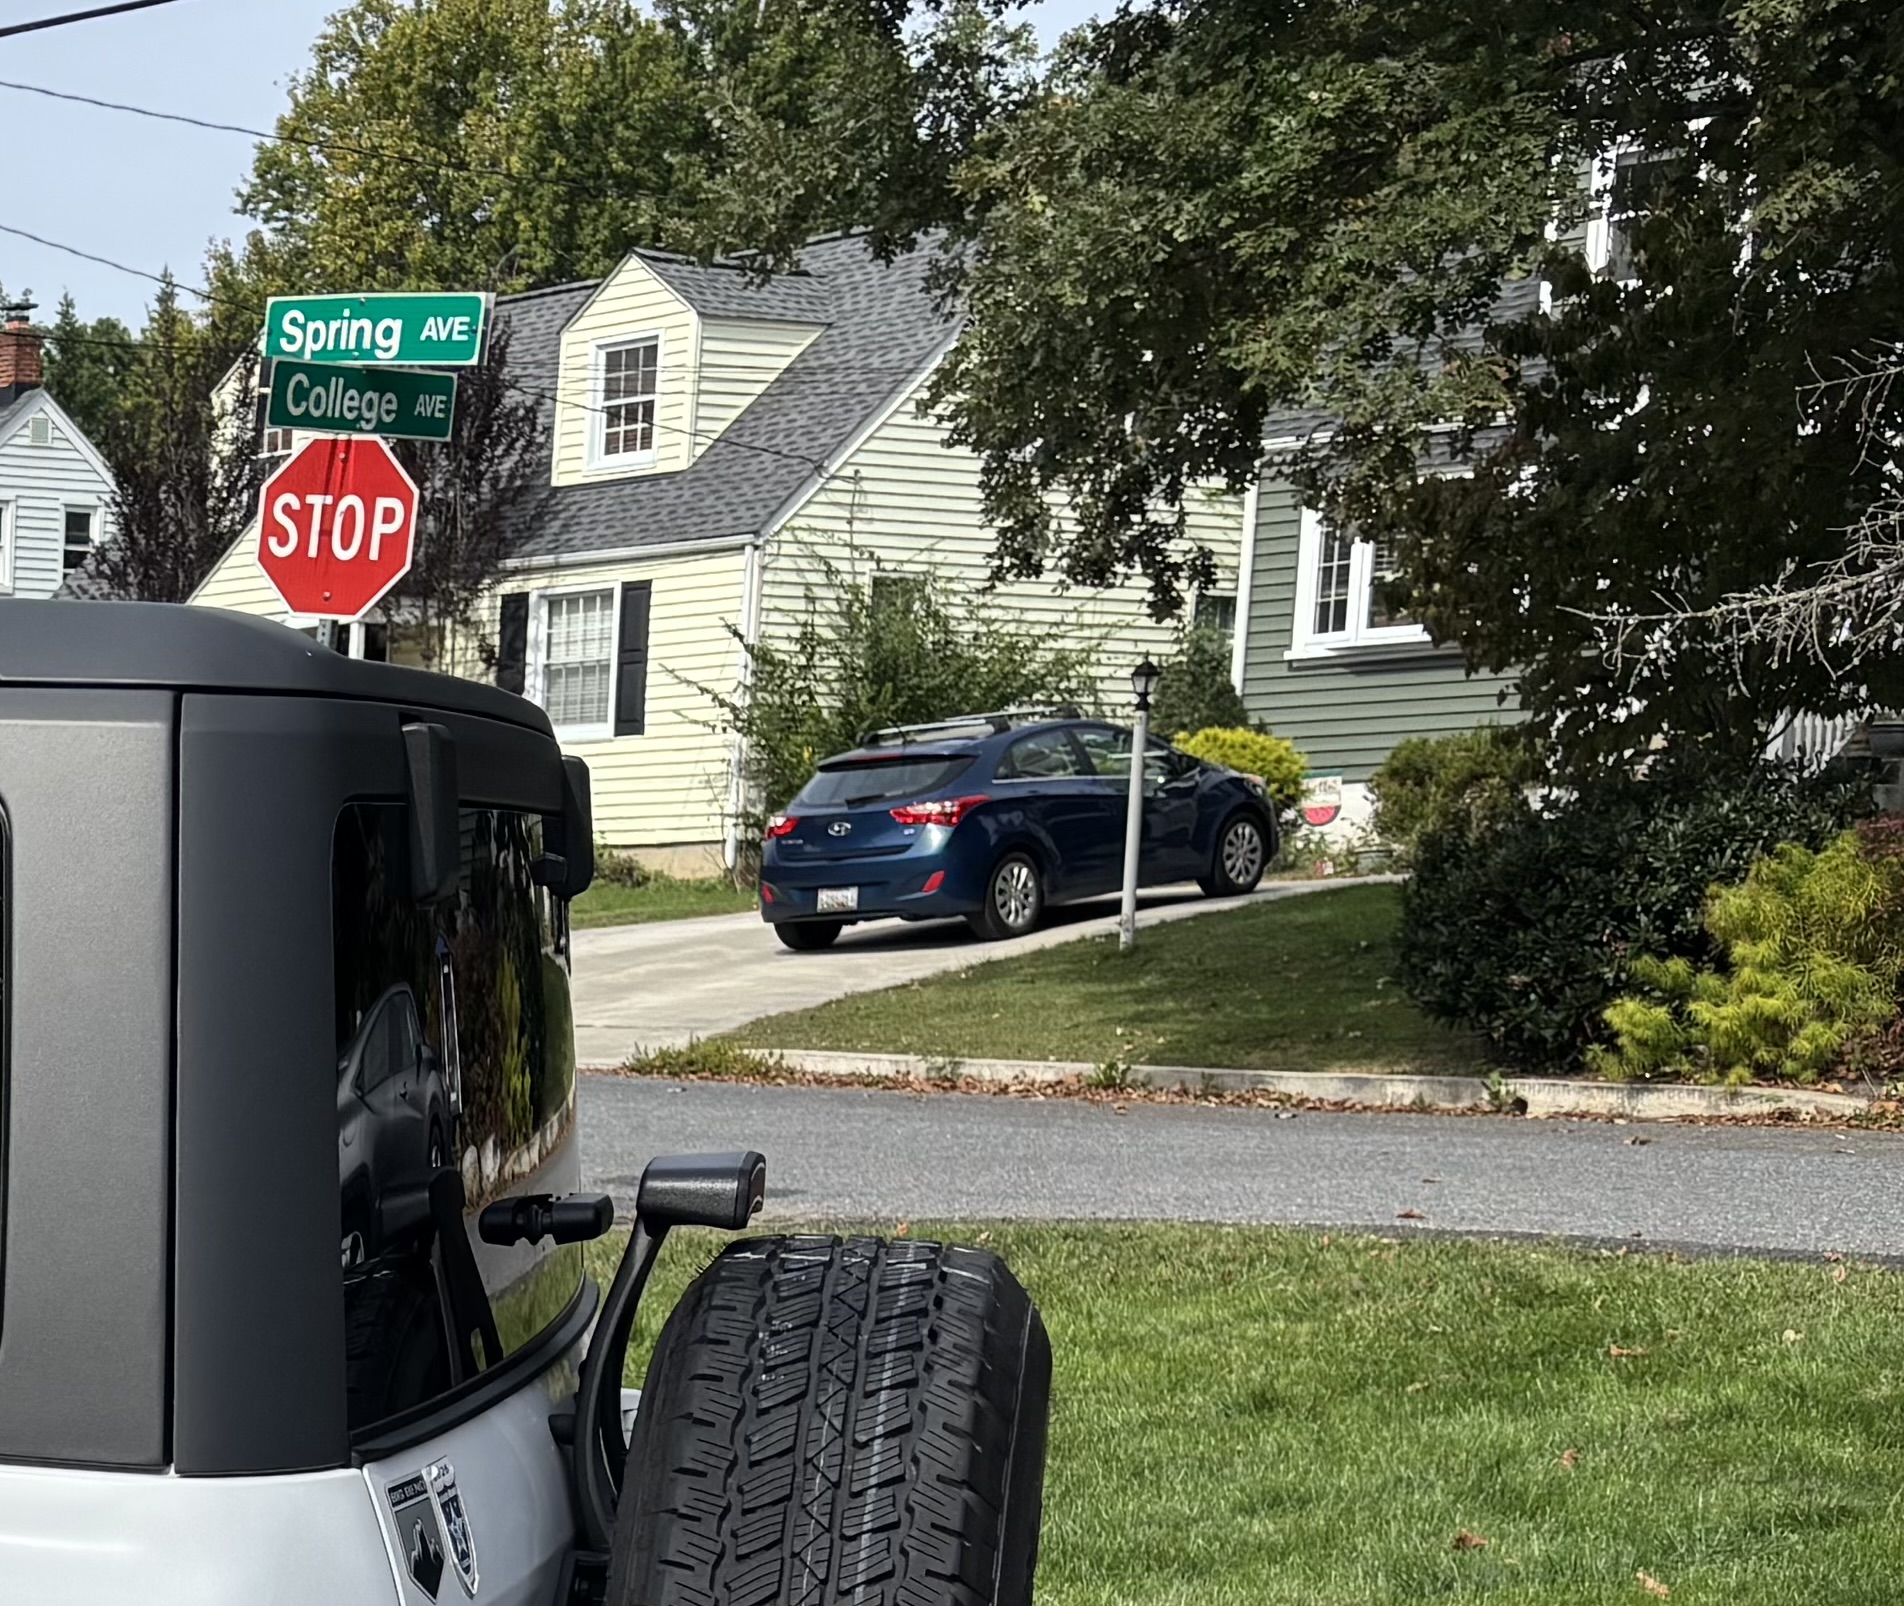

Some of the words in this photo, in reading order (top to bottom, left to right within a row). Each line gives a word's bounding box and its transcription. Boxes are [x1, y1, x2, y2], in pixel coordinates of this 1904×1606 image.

[279, 308, 403, 360] Spring
[420, 315, 470, 342] AVE
[286, 372, 399, 431] College
[414, 395, 447, 419] AVE
[267, 493, 405, 562] STOP
